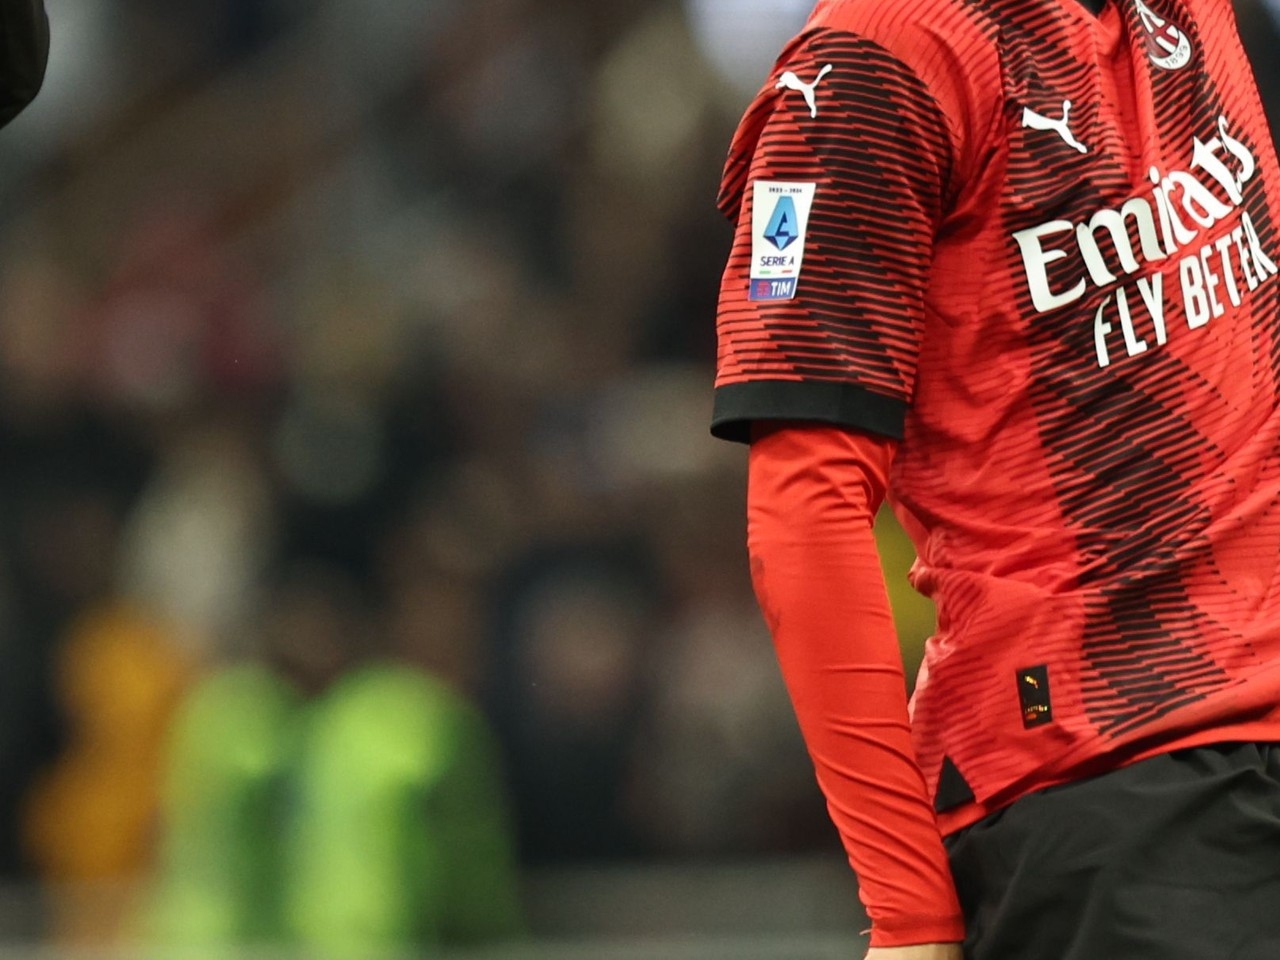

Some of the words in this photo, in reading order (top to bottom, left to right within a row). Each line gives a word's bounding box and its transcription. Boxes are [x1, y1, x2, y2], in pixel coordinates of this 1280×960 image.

[1165, 44, 1188, 68] 1899
[1012, 114, 1255, 313] Emirats
[760, 256, 787, 267] SERIE
[788, 256, 795, 266] A
[771, 281, 791, 297] TIM
[1094, 271, 1167, 368] FLY
